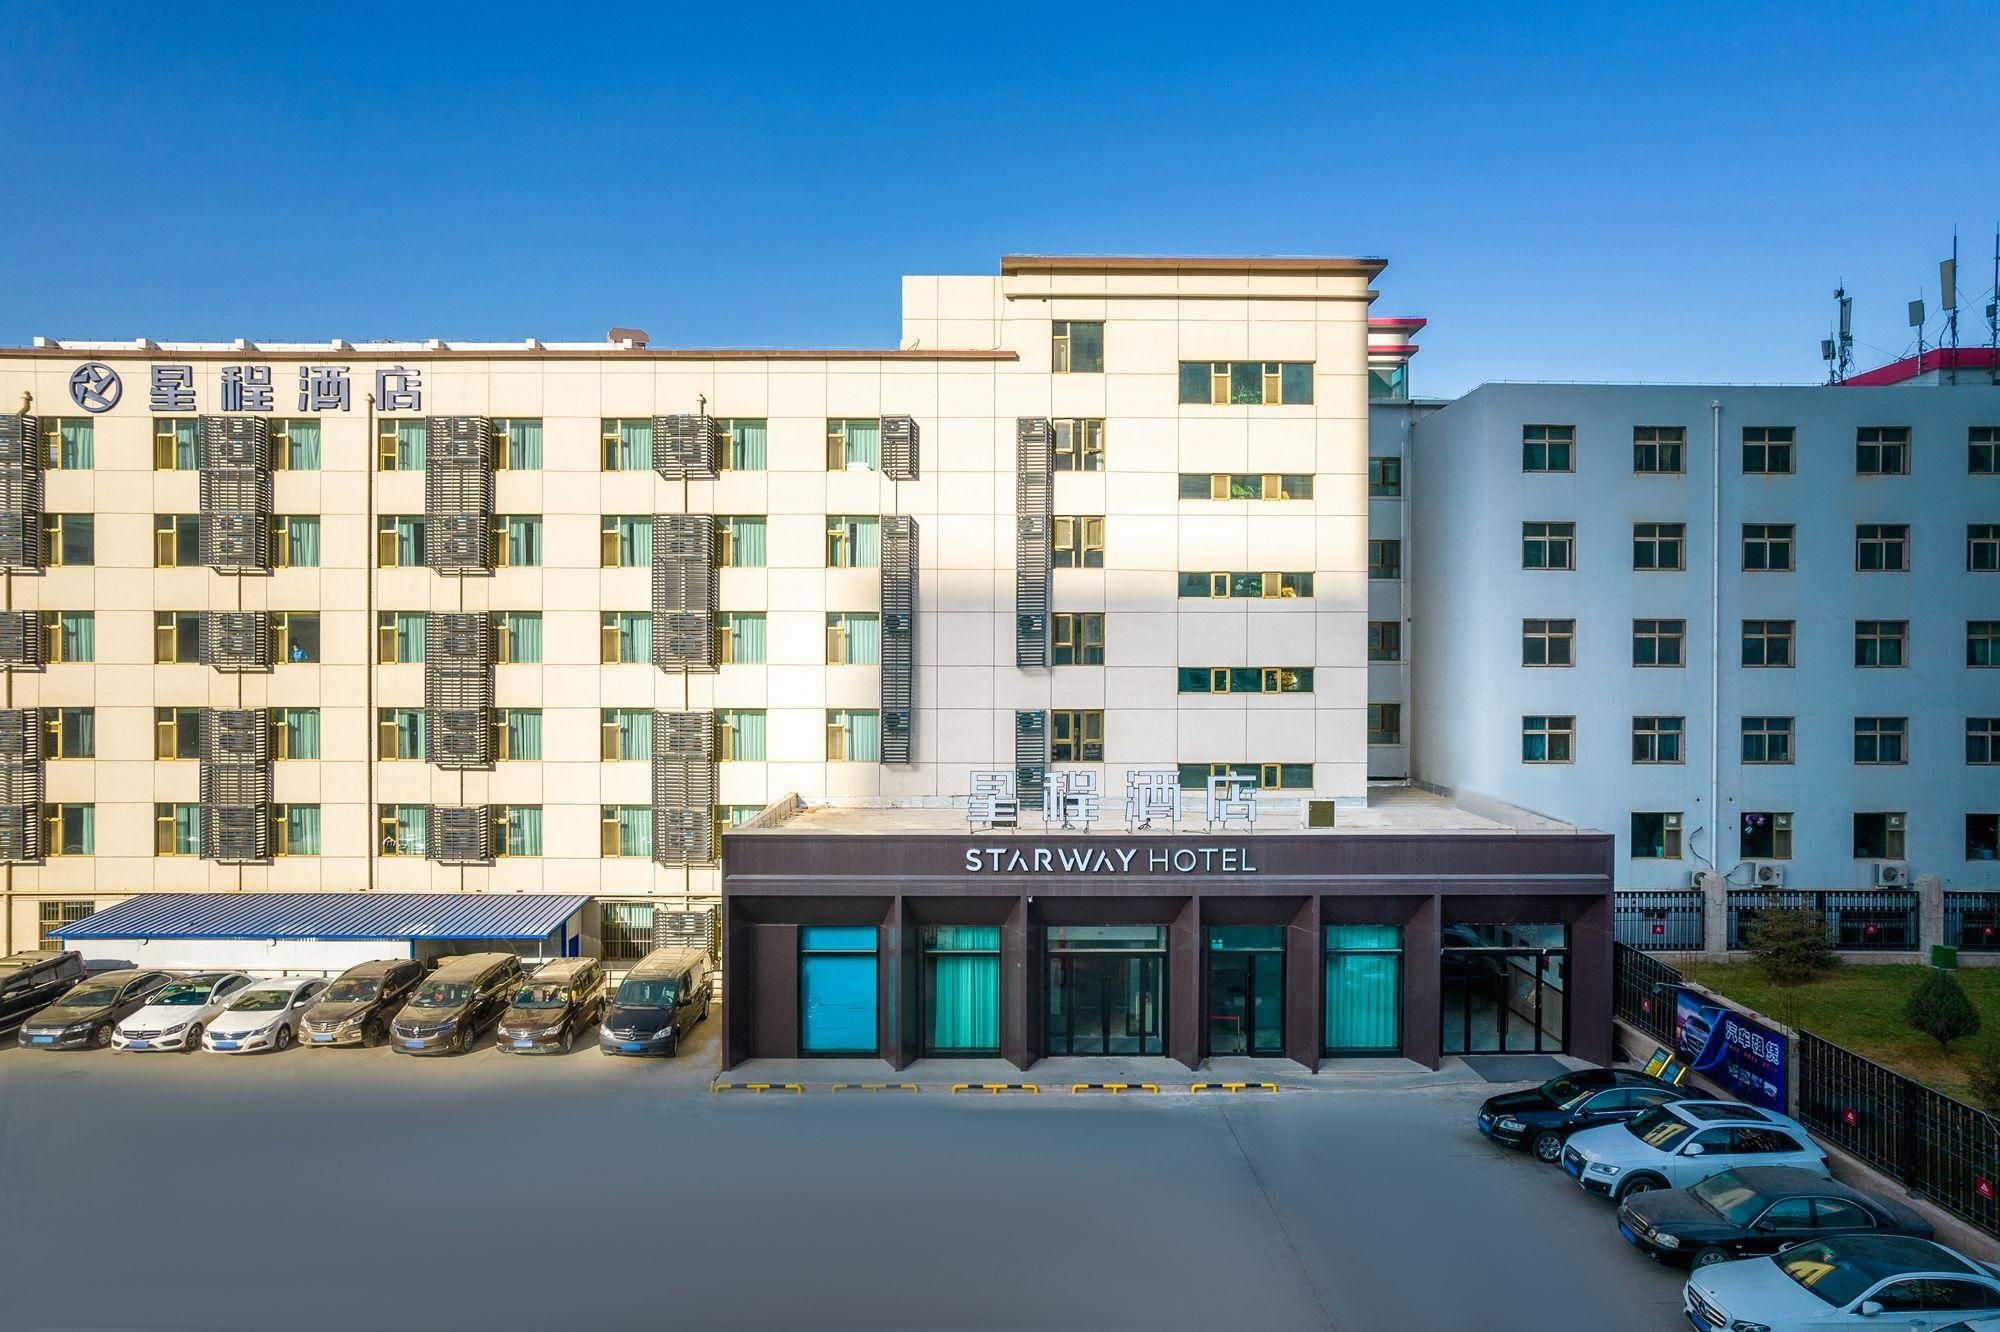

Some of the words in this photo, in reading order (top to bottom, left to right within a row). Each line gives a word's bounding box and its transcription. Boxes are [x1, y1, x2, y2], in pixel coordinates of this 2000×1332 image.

[150, 365, 421, 412] 星程酒店
[966, 770, 1257, 822] 星程酒店
[965, 848, 1138, 872] STARWAY
[1149, 848, 1257, 872] HOTEL
[1725, 1020, 1780, 1066] 汽车租赁
